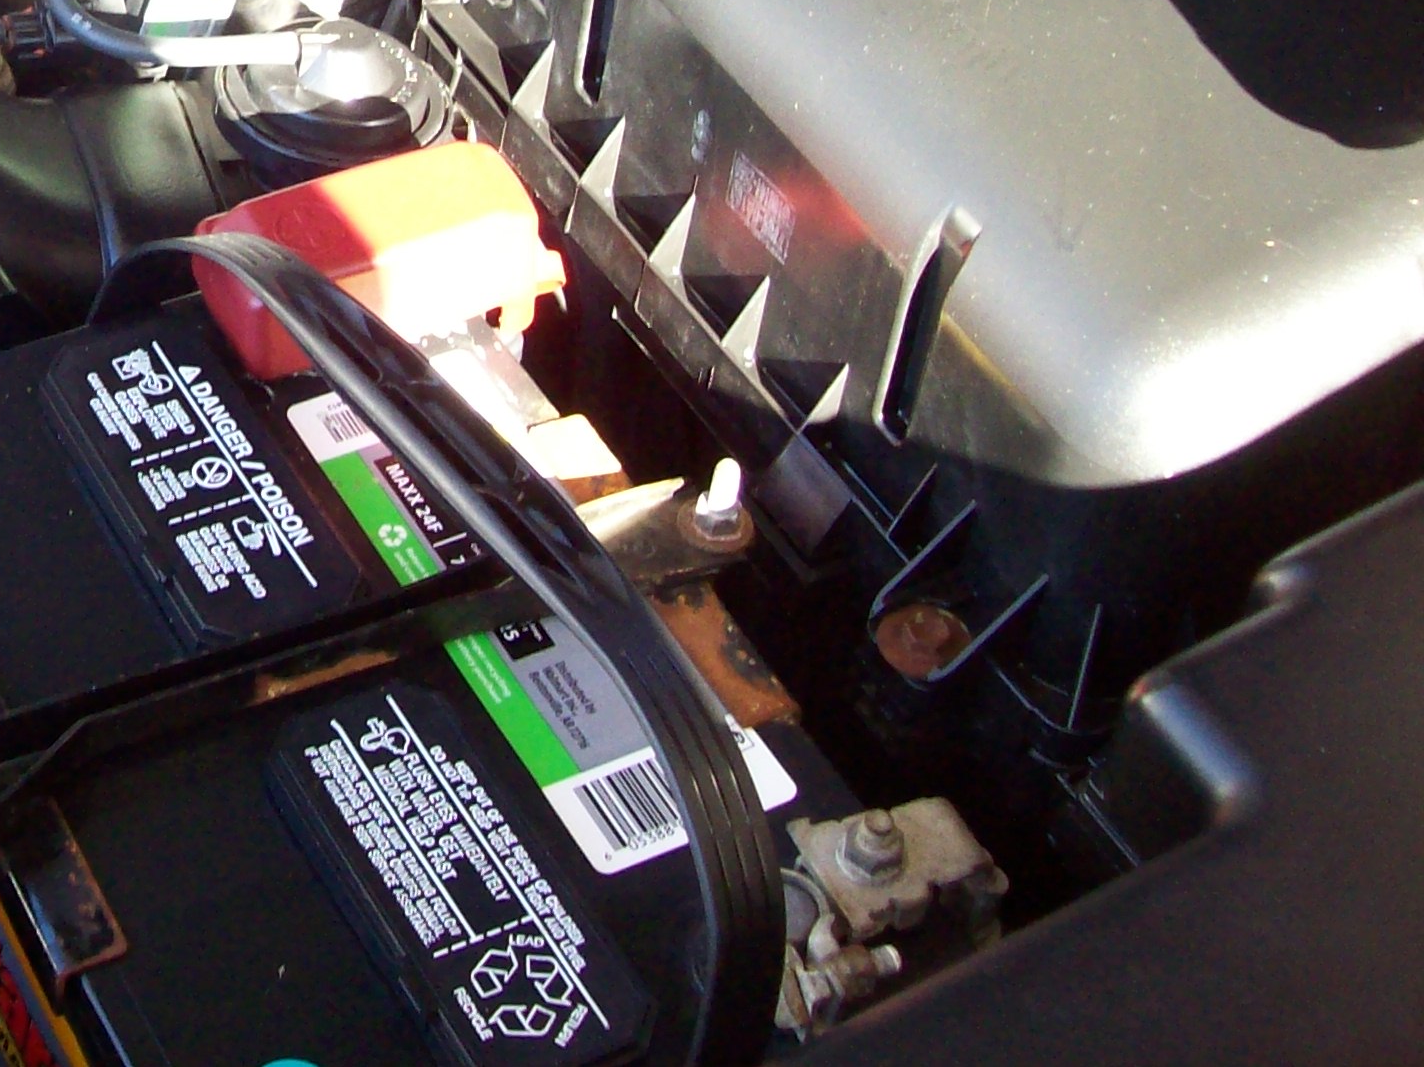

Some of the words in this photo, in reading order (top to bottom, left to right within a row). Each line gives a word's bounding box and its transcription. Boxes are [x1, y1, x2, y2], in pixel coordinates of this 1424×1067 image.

[190, 381, 253, 460] DANGER
[251, 472, 314, 547] POISON
[385, 463, 424, 507] MAXX
[415, 505, 443, 532] 24F
[209, 522, 250, 577] SULFURIC
[241, 571, 267, 598] ACID
[373, 764, 412, 818] MEDICAL
[406, 816, 435, 847] HELP
[427, 848, 457, 880] FAST
[389, 758, 417, 791] WITH
[438, 835, 464, 860] GET
[402, 751, 437, 793] FLUSH
[428, 791, 458, 824] EYES
[450, 823, 511, 901] IMMEDIATELY
[440, 761, 461, 783] NOT
[469, 800, 492, 830] KEEP
[455, 760, 477, 786] KEEP
[472, 786, 493, 813] OUT
[486, 808, 504, 823] OF
[497, 823, 518, 846] THE
[511, 845, 540, 880] REACH
[534, 879, 552, 897] OF
[545, 895, 585, 949] CHILDREN
[430, 896, 461, 936] FOLLOW
[508, 934, 546, 948] LEAD
[454, 987, 493, 1041] RECYCLE
